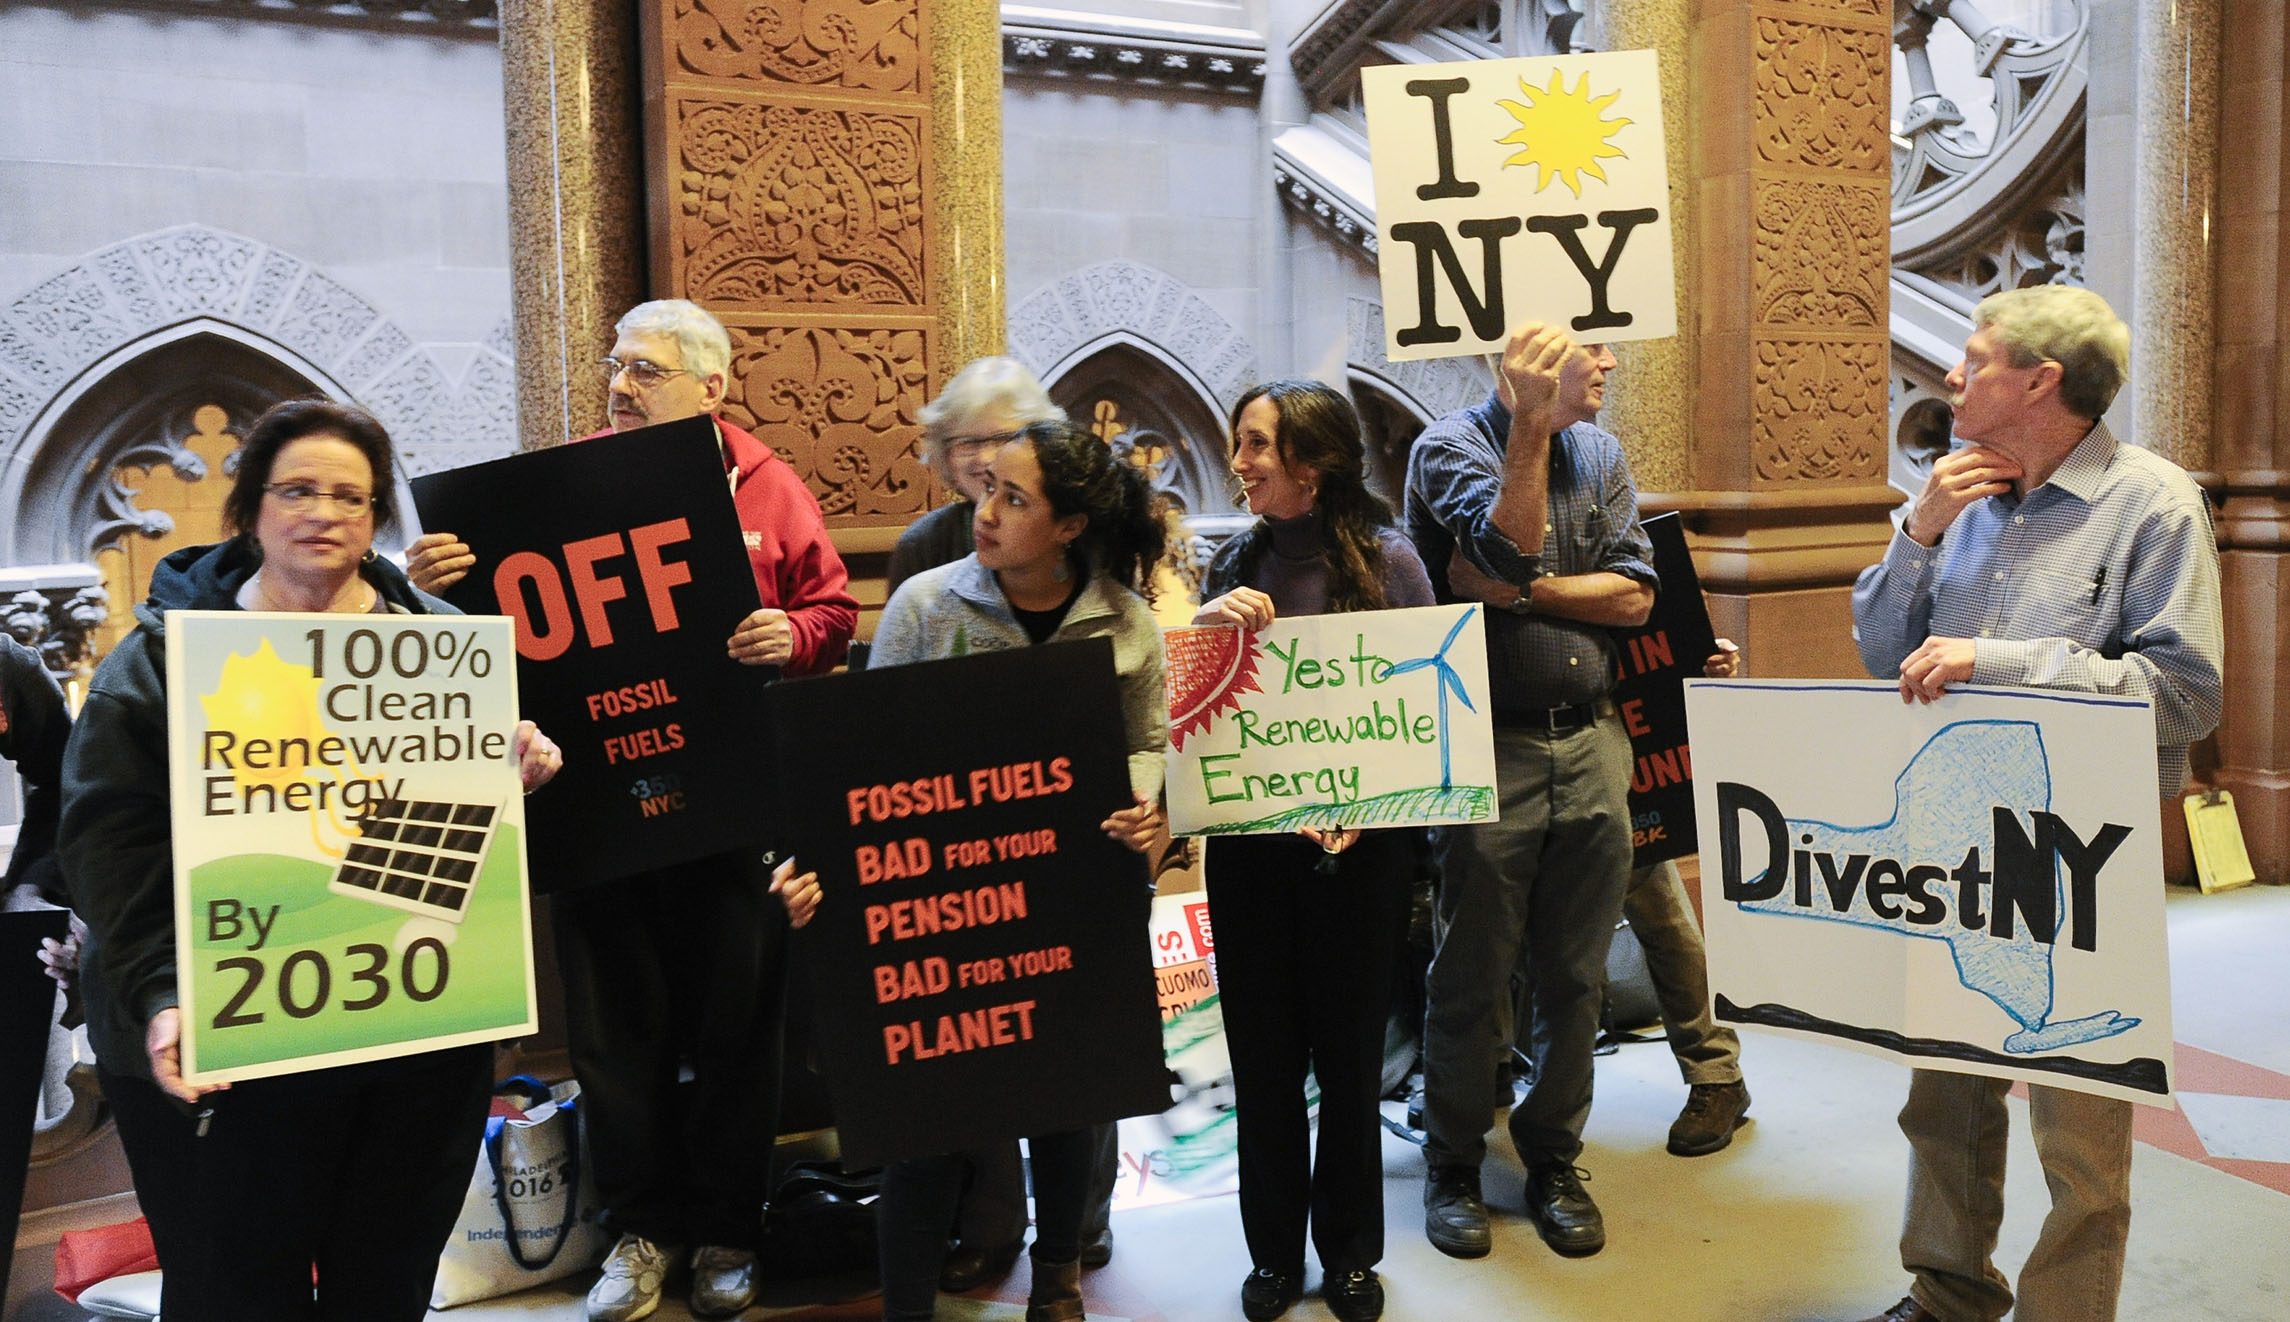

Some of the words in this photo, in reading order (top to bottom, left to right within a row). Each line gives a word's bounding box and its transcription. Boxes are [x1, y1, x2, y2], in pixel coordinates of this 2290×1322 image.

[1406, 77, 1480, 201] I
[1390, 207, 1659, 347] NY
[493, 517, 692, 661] OFF
[306, 629, 491, 679] 100%
[1264, 638, 1346, 694] Yes
[1349, 633, 1396, 688] to
[1628, 631, 1675, 675] IN
[326, 684, 471, 722] Clean
[586, 678, 678, 721] FOSSIL
[1232, 698, 1436, 749] Renewable
[203, 726, 505, 770] Renewable
[604, 723, 685, 765] FUELS
[204, 776, 404, 822] Energy
[640, 791, 687, 818] NYC
[846, 774, 966, 826] FOSSIL
[968, 756, 1074, 806] FUELS
[1199, 753, 1360, 806] Energy
[855, 837, 932, 886] BAD
[943, 839, 991, 871] FOR
[993, 828, 1058, 862] YOUR
[1632, 825, 1668, 848] BK
[208, 899, 280, 951] By
[864, 880, 1028, 945] PENSION
[212, 937, 449, 1029] 2030
[873, 956, 951, 1004] BAD
[957, 961, 1006, 989] FOR
[1007, 945, 1074, 979] YOUR
[1156, 968, 1210, 997] CUOMO
[882, 1000, 1037, 1065] PLANET
